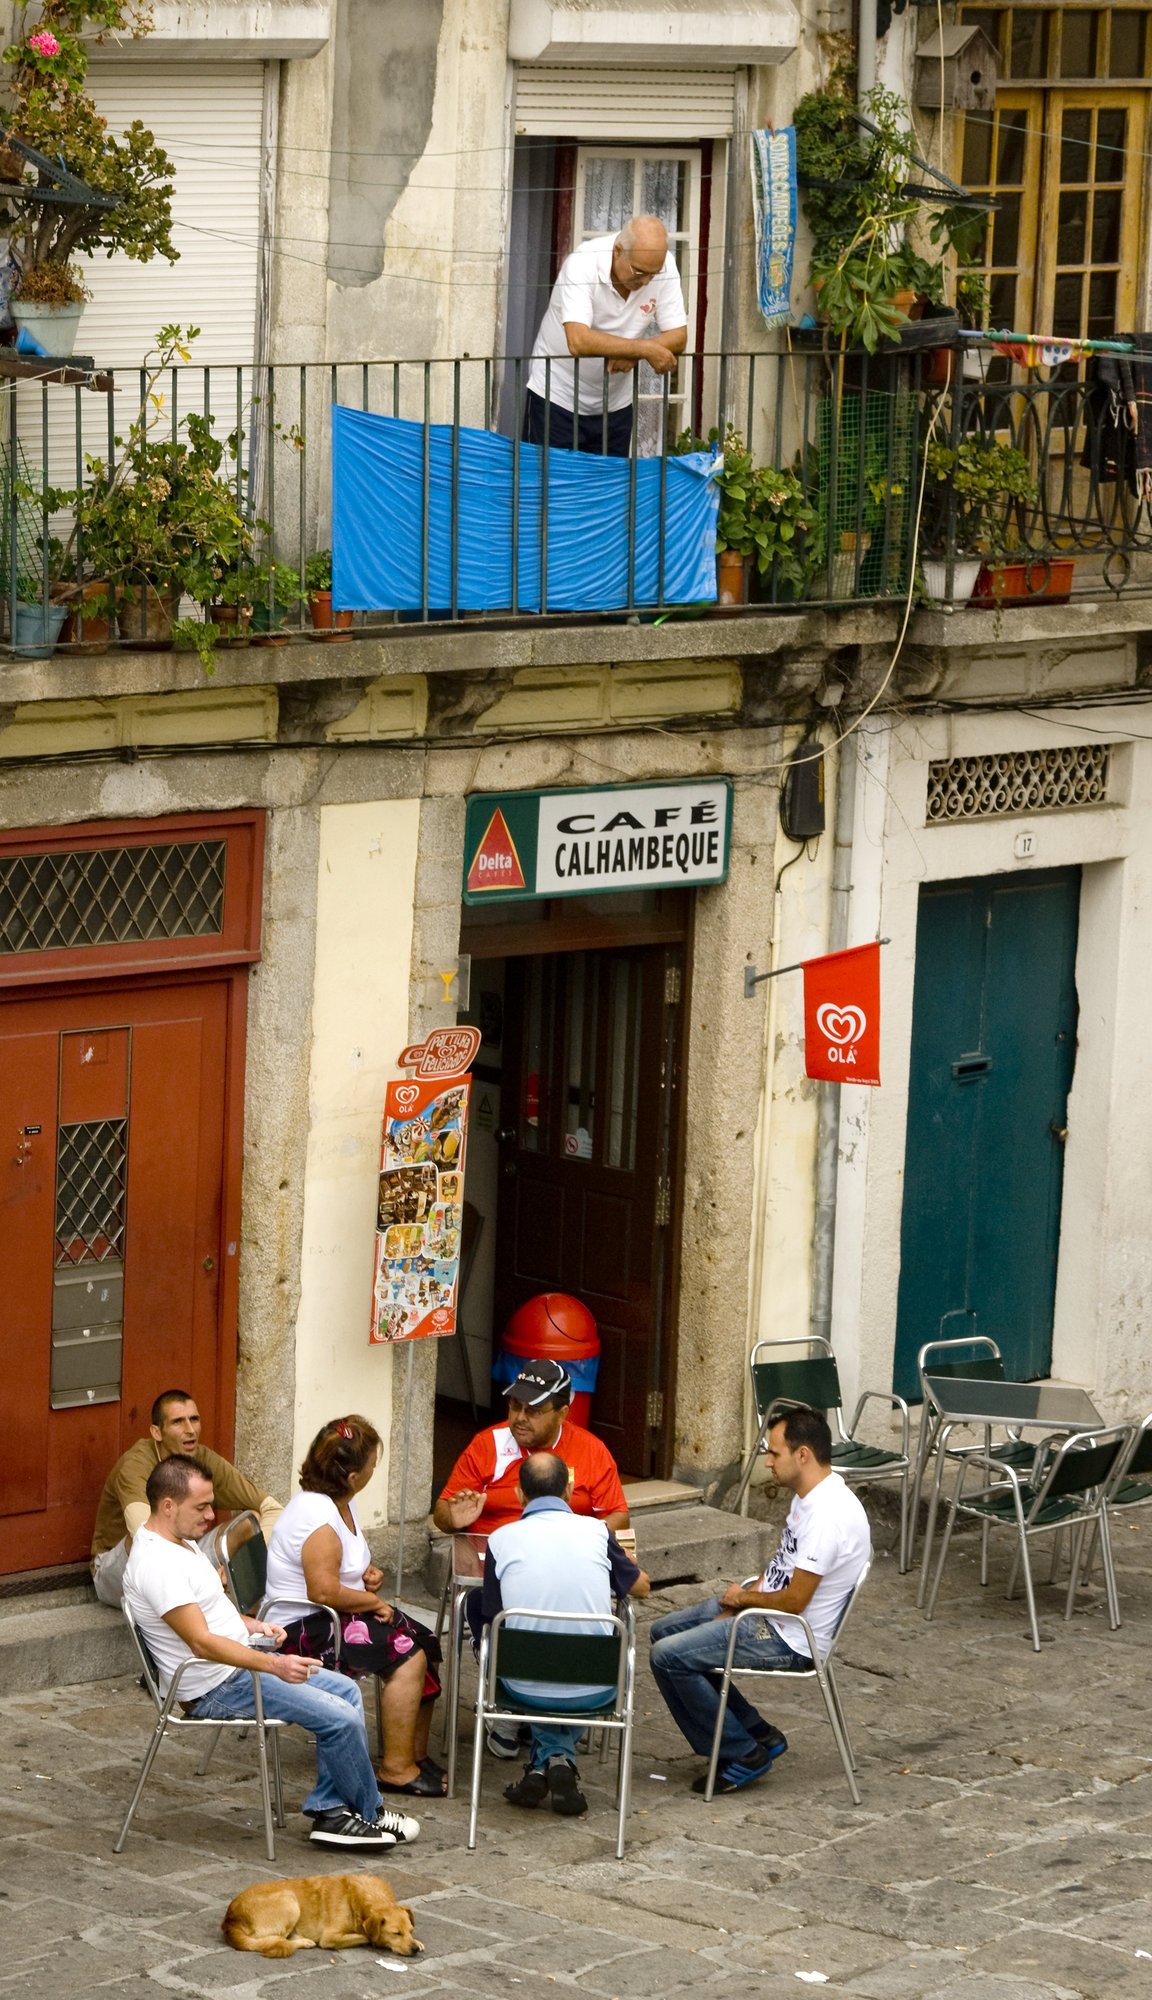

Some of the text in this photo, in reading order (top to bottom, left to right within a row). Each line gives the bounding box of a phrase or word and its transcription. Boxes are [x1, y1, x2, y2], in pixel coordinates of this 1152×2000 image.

[769, 133, 794, 251] SOMOS CAMPEÕES
[556, 800, 720, 835] CAFÉ
[555, 830, 720, 878] CALHAMBEQUE
[1023, 838, 1032, 852] 17
[478, 852, 513, 871] Delta
[827, 1045, 857, 1065] OLÁ
